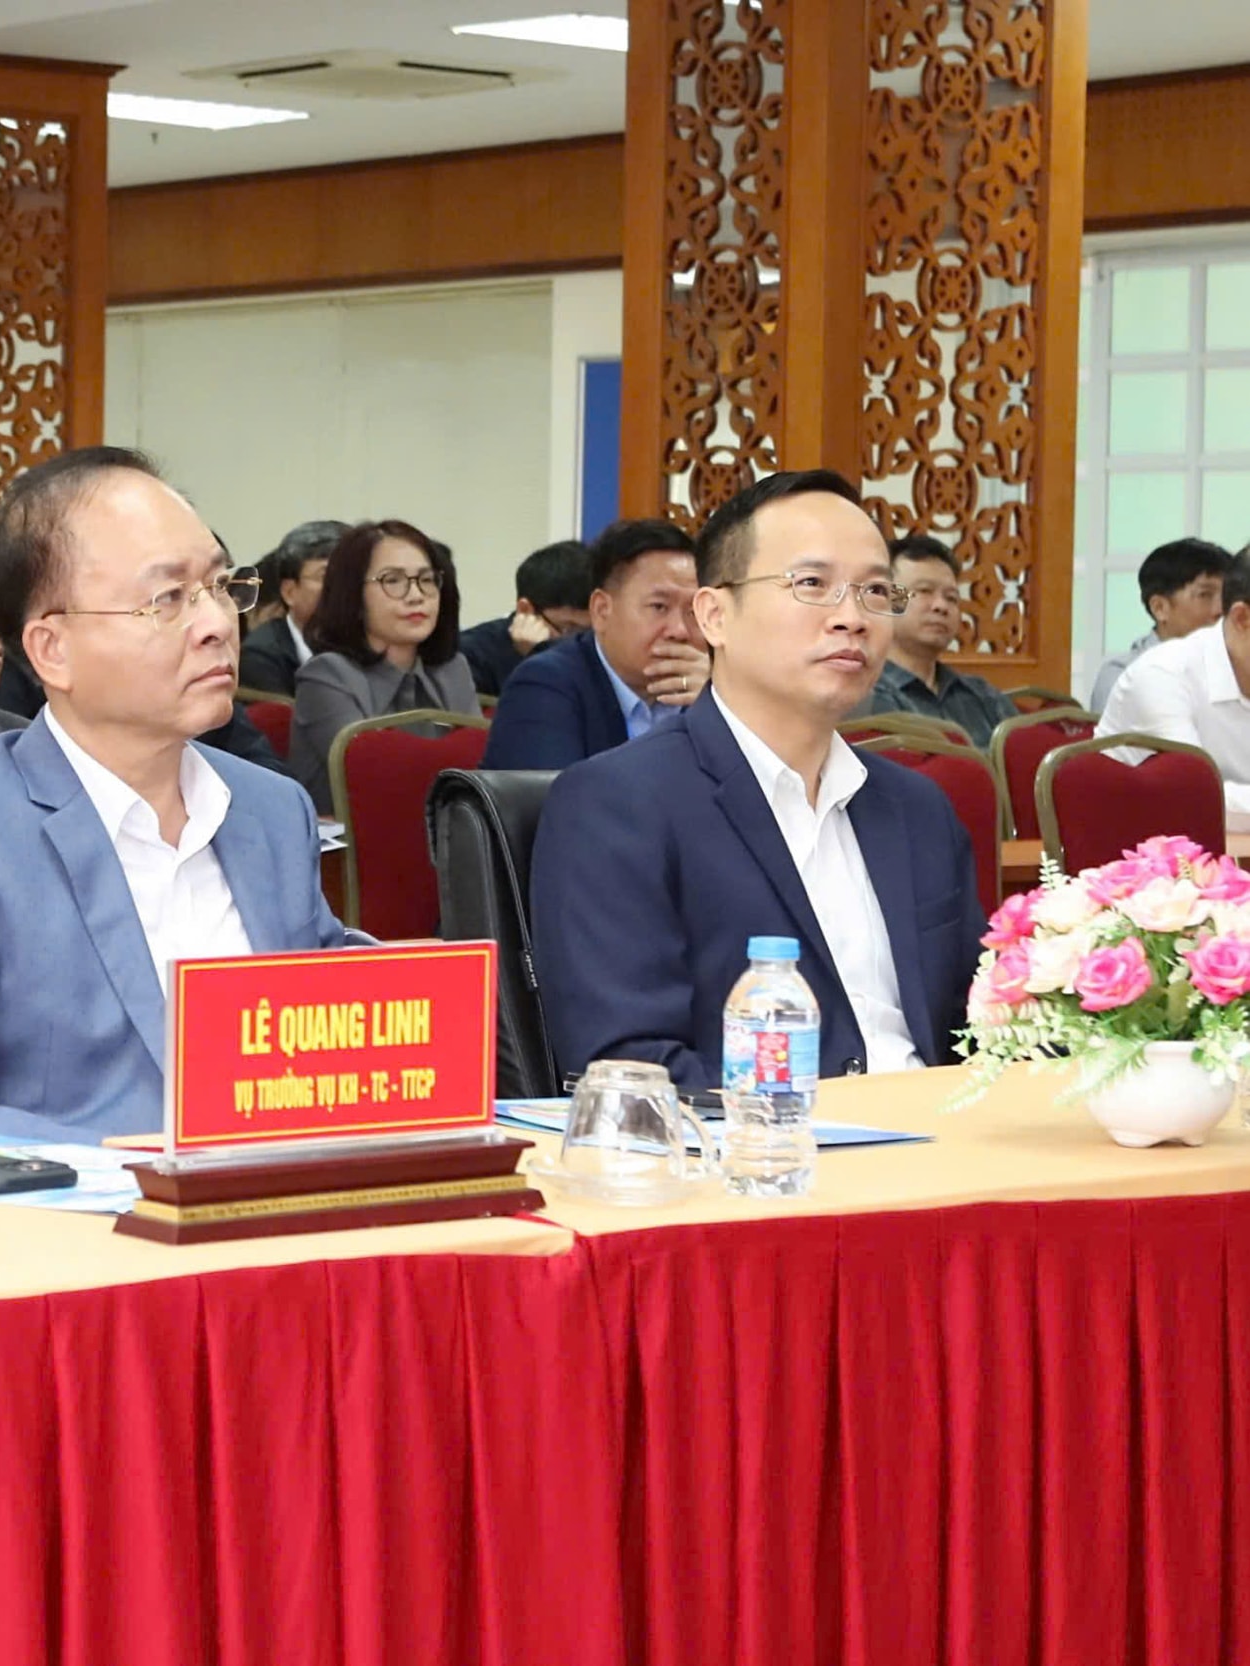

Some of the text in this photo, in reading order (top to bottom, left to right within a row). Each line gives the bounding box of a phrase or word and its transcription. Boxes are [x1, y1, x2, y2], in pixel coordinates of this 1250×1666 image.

[241, 997, 431, 1058] LÊ QUANG LINH
[234, 1080, 254, 1119] VỤ
[317, 1074, 336, 1113] VỤ
[338, 1073, 359, 1105] KH
[370, 1071, 389, 1102] TC
[401, 1067, 436, 1100] TTCP
